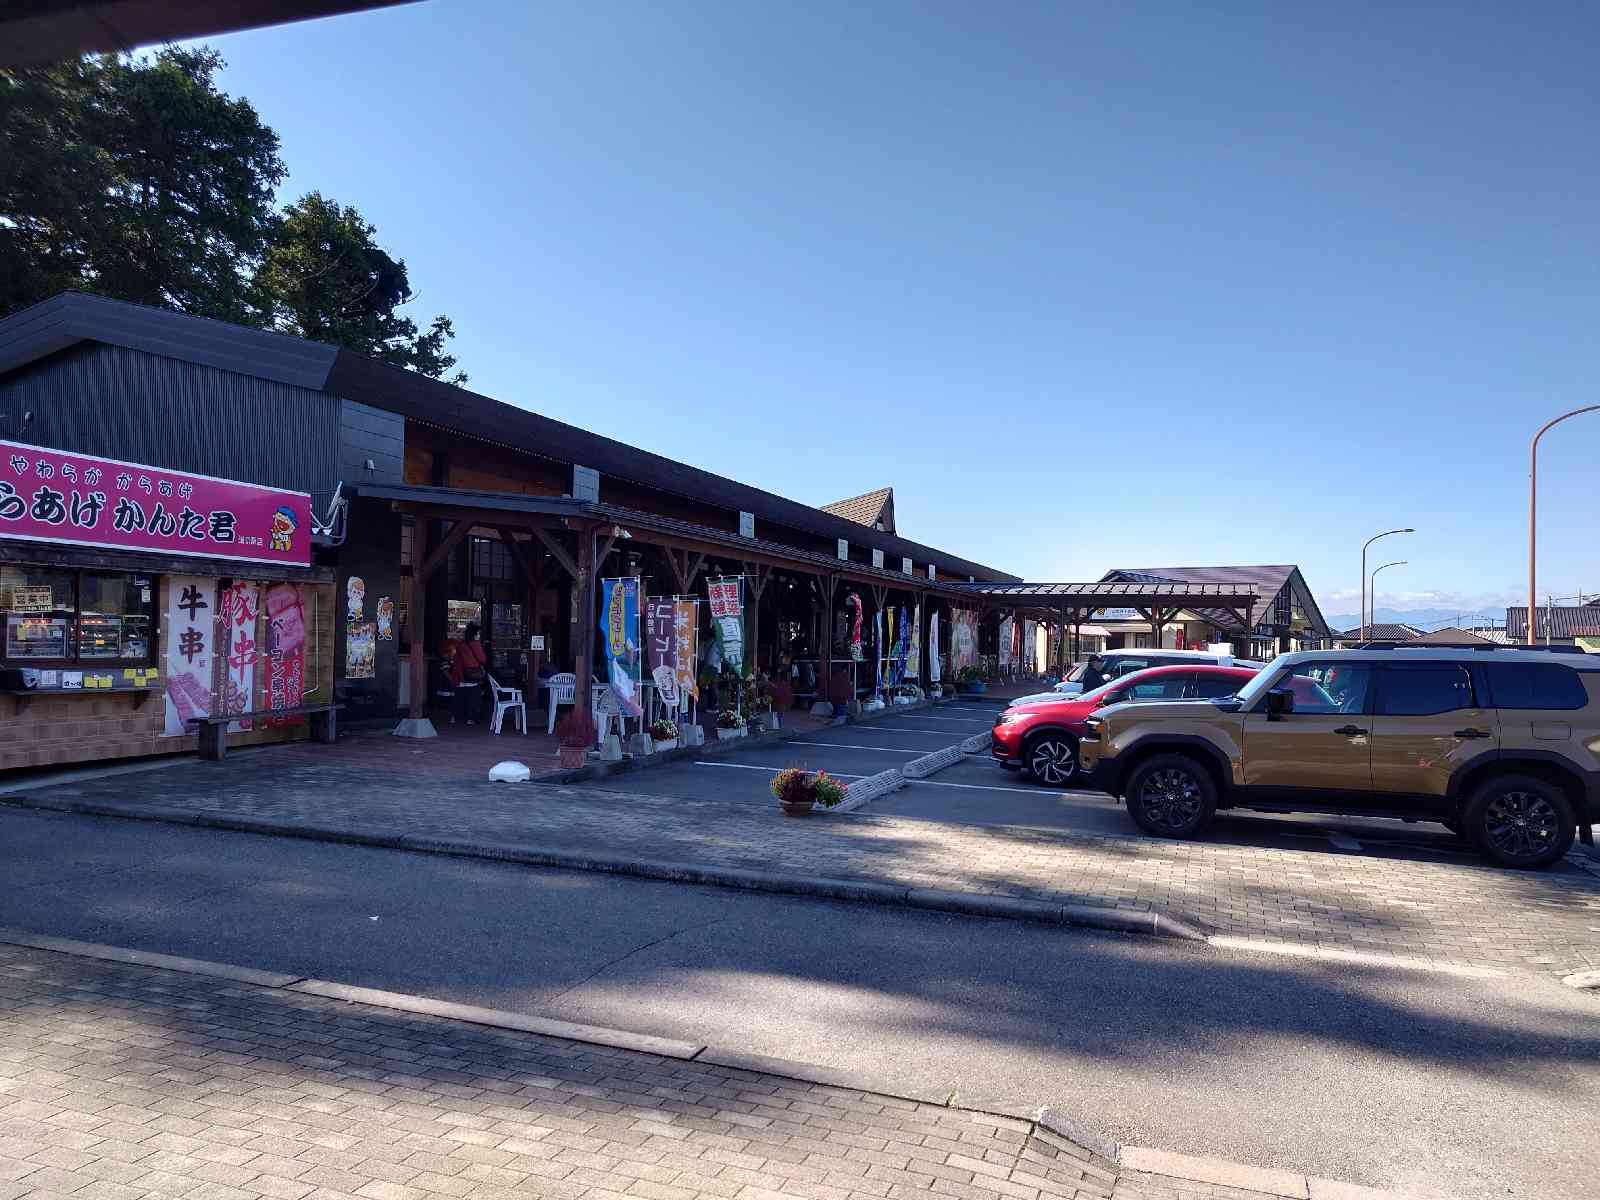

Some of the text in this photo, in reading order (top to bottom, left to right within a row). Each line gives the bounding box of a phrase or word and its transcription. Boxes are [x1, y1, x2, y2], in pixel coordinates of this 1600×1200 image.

[10, 455, 102, 486] やわらか
[113, 497, 237, 544] かんた君
[178, 585, 208, 664] 牛串
[217, 580, 259, 687] 豚串
